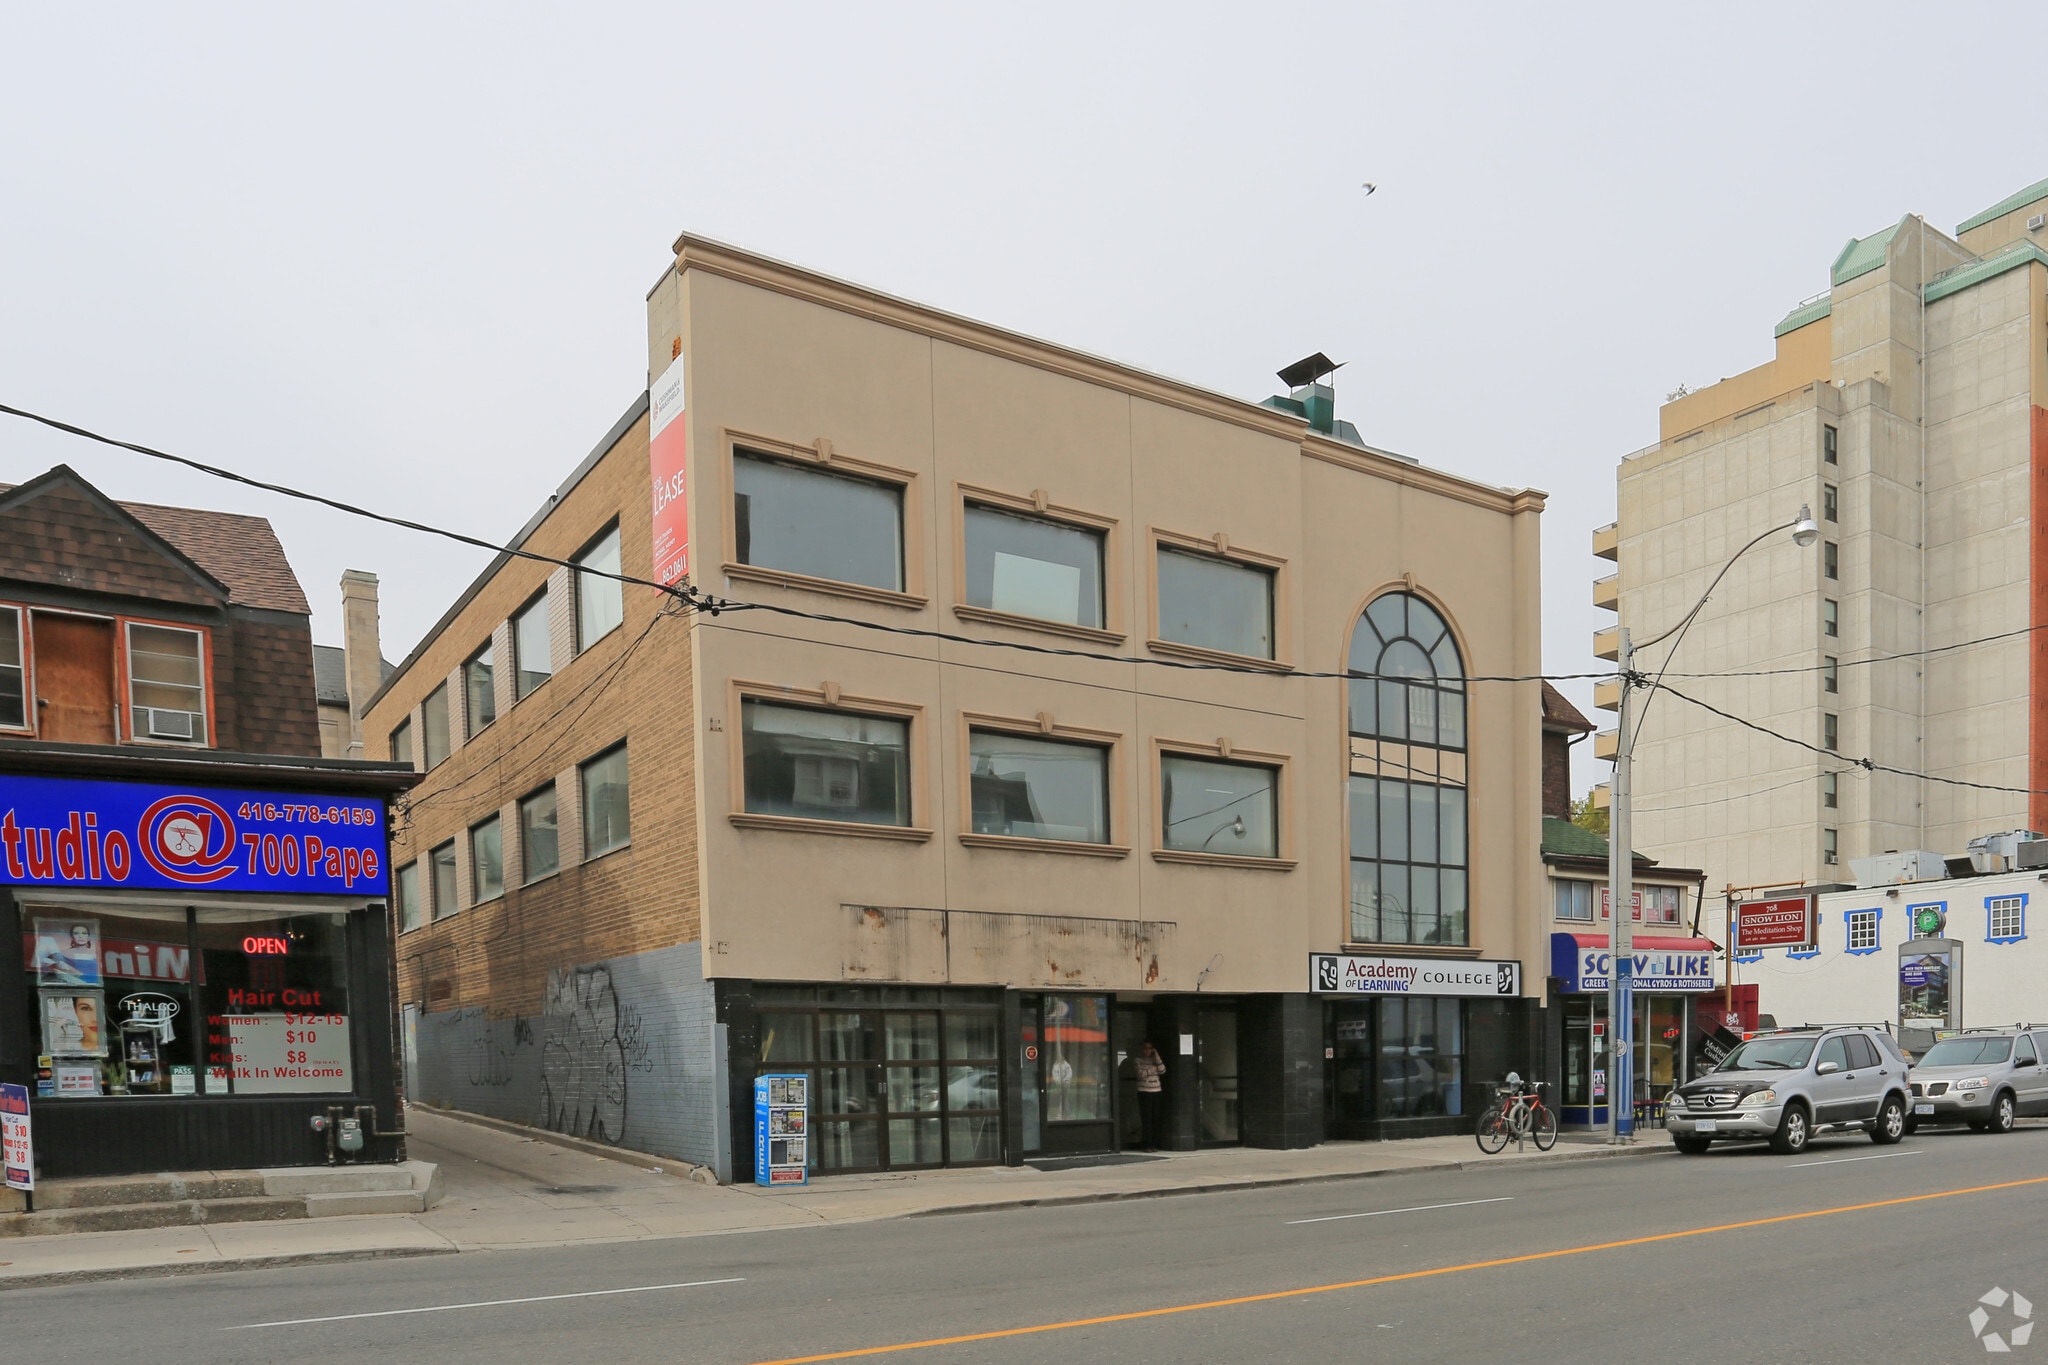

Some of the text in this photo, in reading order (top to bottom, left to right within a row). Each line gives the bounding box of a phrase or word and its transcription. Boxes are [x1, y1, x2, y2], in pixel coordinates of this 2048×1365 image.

[653, 469, 685, 517] LEASE
[238, 802, 376, 826] 416-778-6159
[242, 832, 378, 888] 700 Pape
[1766, 903, 1778, 913] 708
[1744, 913, 1799, 925] SNOW LION
[1753, 926, 1785, 935] Meditation
[1786, 925, 1803, 933] Shop
[243, 937, 287, 954] OPEN
[1345, 959, 1493, 985] Academy COLLEGE
[1665, 955, 1710, 976] LIKE
[1345, 979, 1409, 992] OF LEARNING
[1584, 979, 1606, 987] GREEK
[1651, 979, 1673, 988] GYROS
[228, 988, 321, 1005] Hair Cut
[286, 1011, 343, 1026] $12-15
[209, 1030, 317, 1045] Men: $10
[210, 1052, 247, 1063] Kids:
[287, 1050, 307, 1064] $8
[213, 1067, 343, 1078] Walk In Welcome
